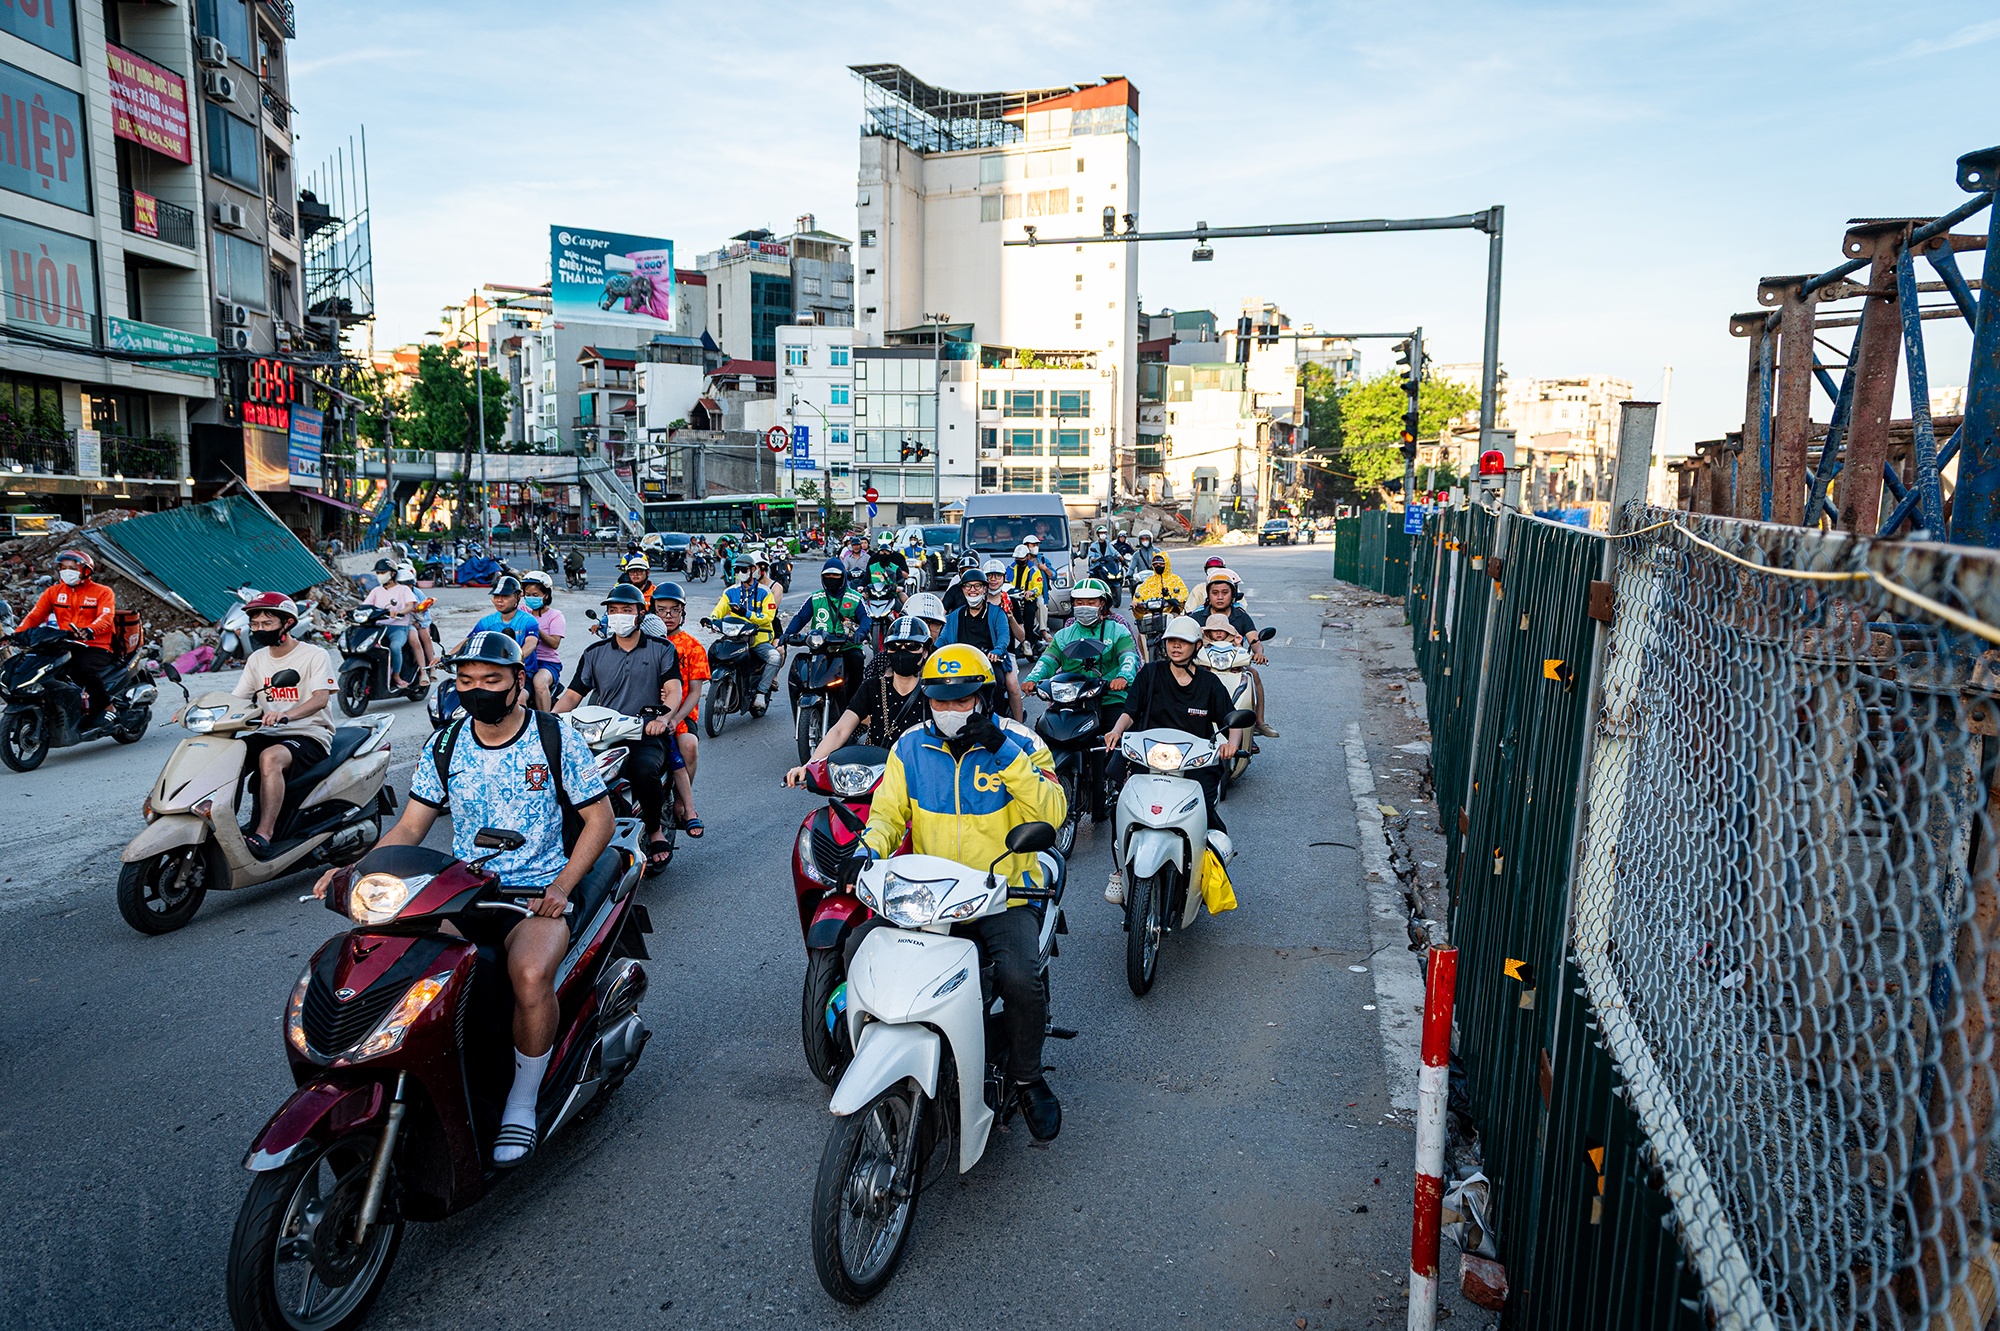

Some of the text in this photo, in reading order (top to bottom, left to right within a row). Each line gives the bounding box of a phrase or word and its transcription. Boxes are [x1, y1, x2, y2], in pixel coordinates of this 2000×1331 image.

[138, 87, 161, 112] 316B
[0, 93, 75, 190] HIỆP
[572, 234, 610, 250] Casper
[760, 242, 788, 257] HOTEL
[558, 257, 604, 276] ĐIỀU HÒA
[558, 270, 604, 285] THÁI LAN
[10, 243, 86, 331] HÒA
[937, 657, 961, 674] be
[271, 687, 299, 699] NAM
[973, 765, 1002, 792] be
[897, 938, 925, 947] HONDA
